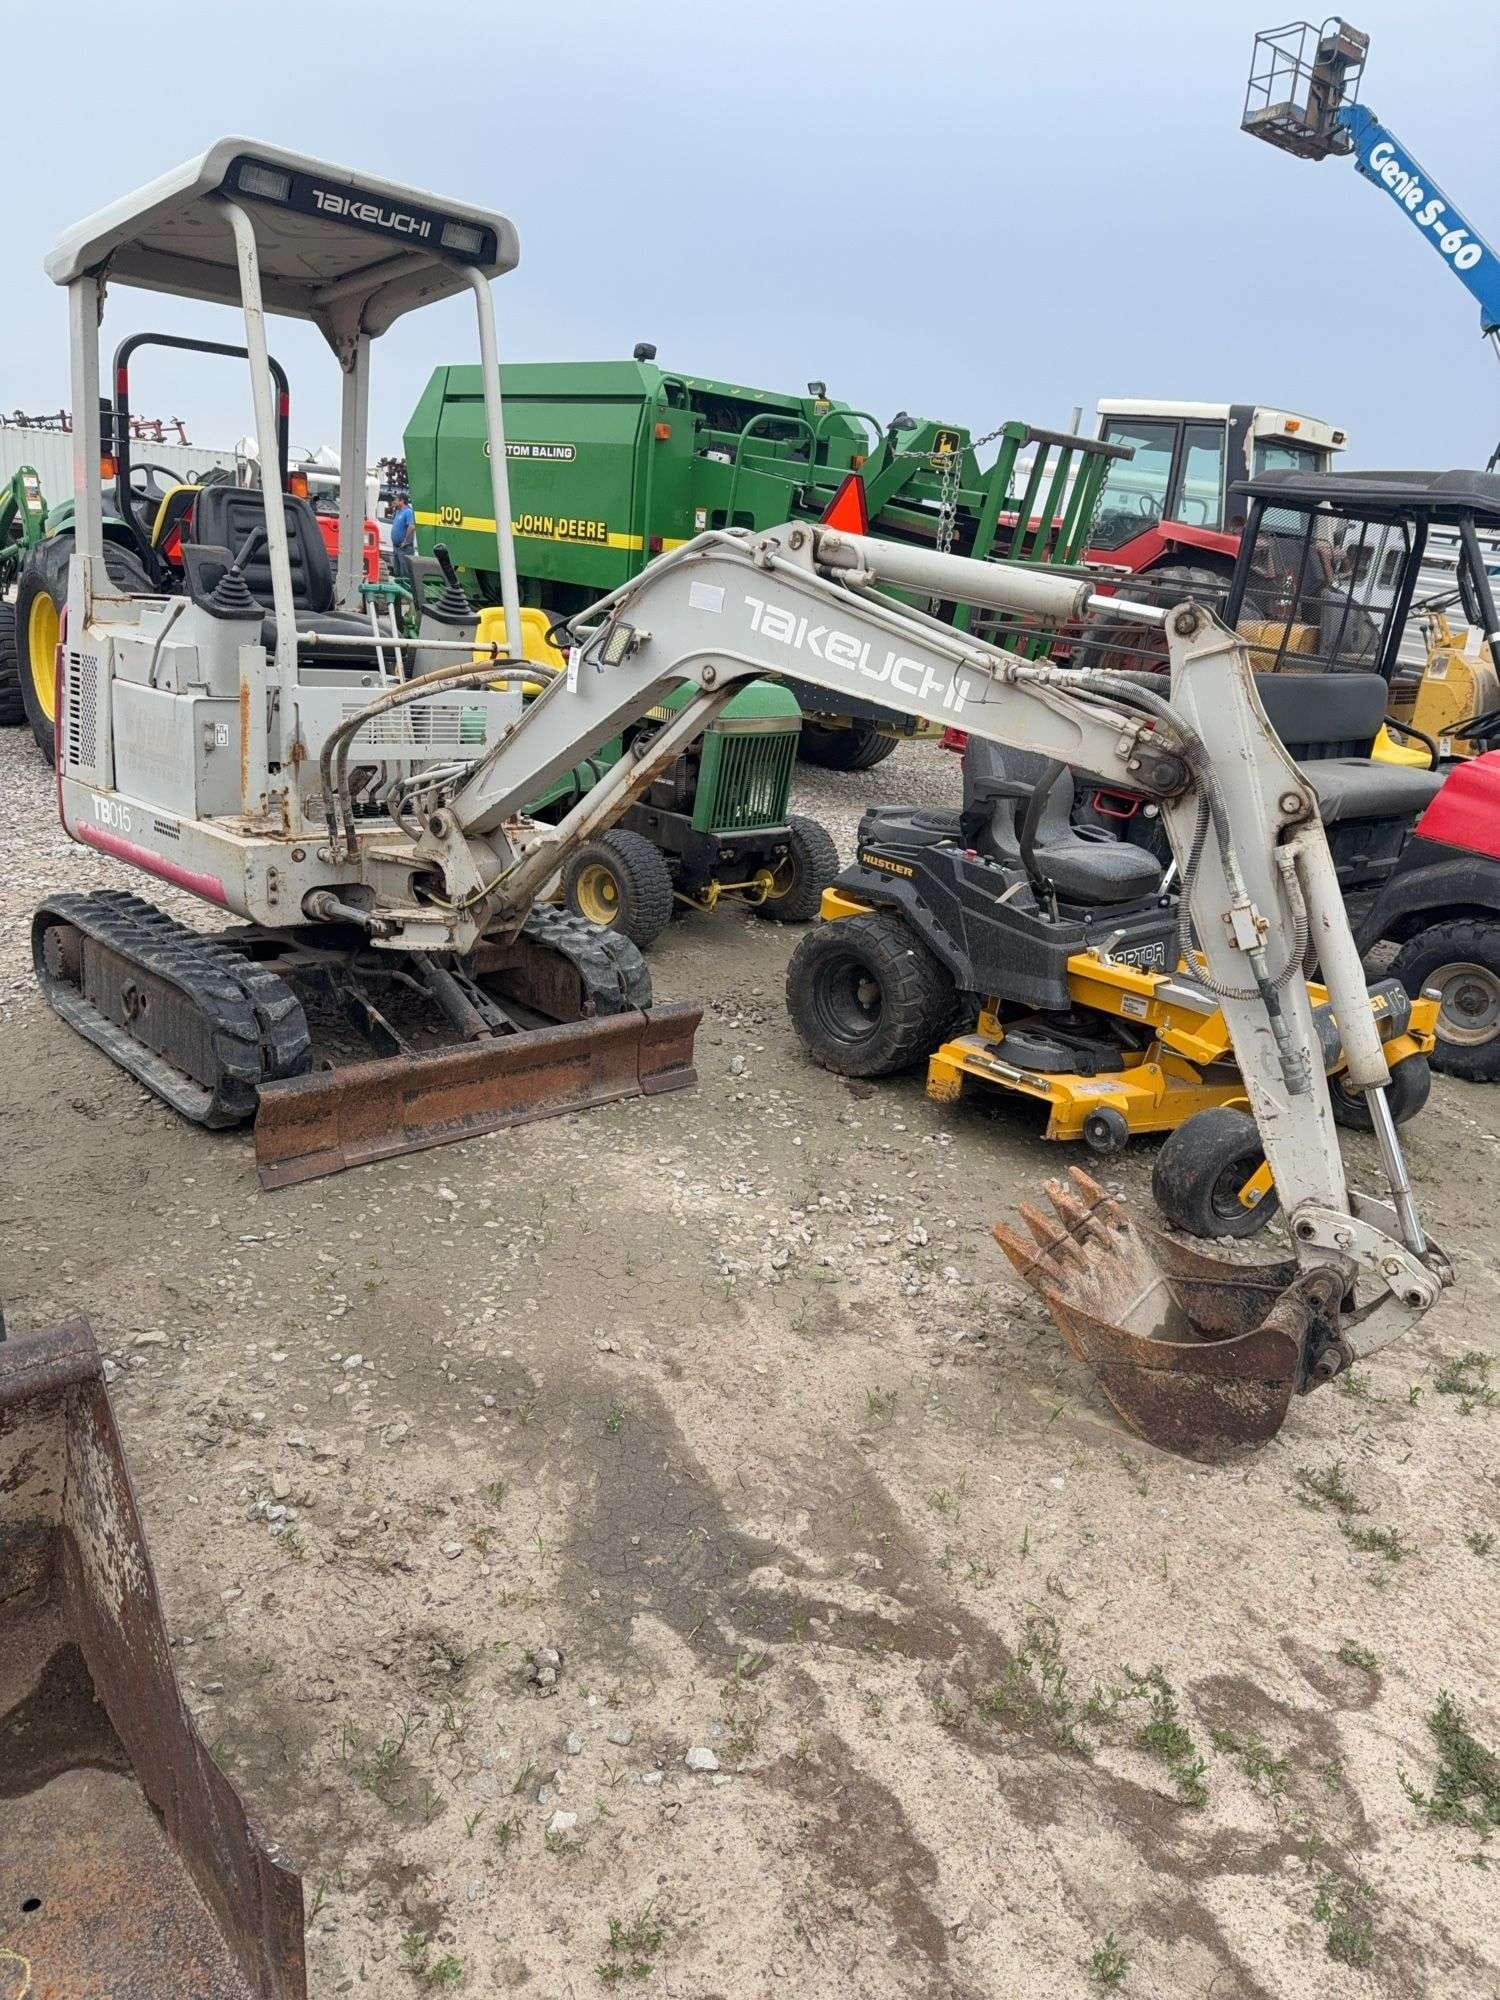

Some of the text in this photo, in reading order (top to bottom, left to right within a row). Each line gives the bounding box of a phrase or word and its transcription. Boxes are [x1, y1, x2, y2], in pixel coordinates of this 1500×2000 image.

[1369, 142, 1483, 270] Genie S-60
[532, 446, 572, 458] BALING
[440, 506, 462, 523] 100
[515, 513, 607, 540] JOHN DEERE
[91, 794, 132, 832] TB015
[863, 853, 913, 877] HUSTLER
